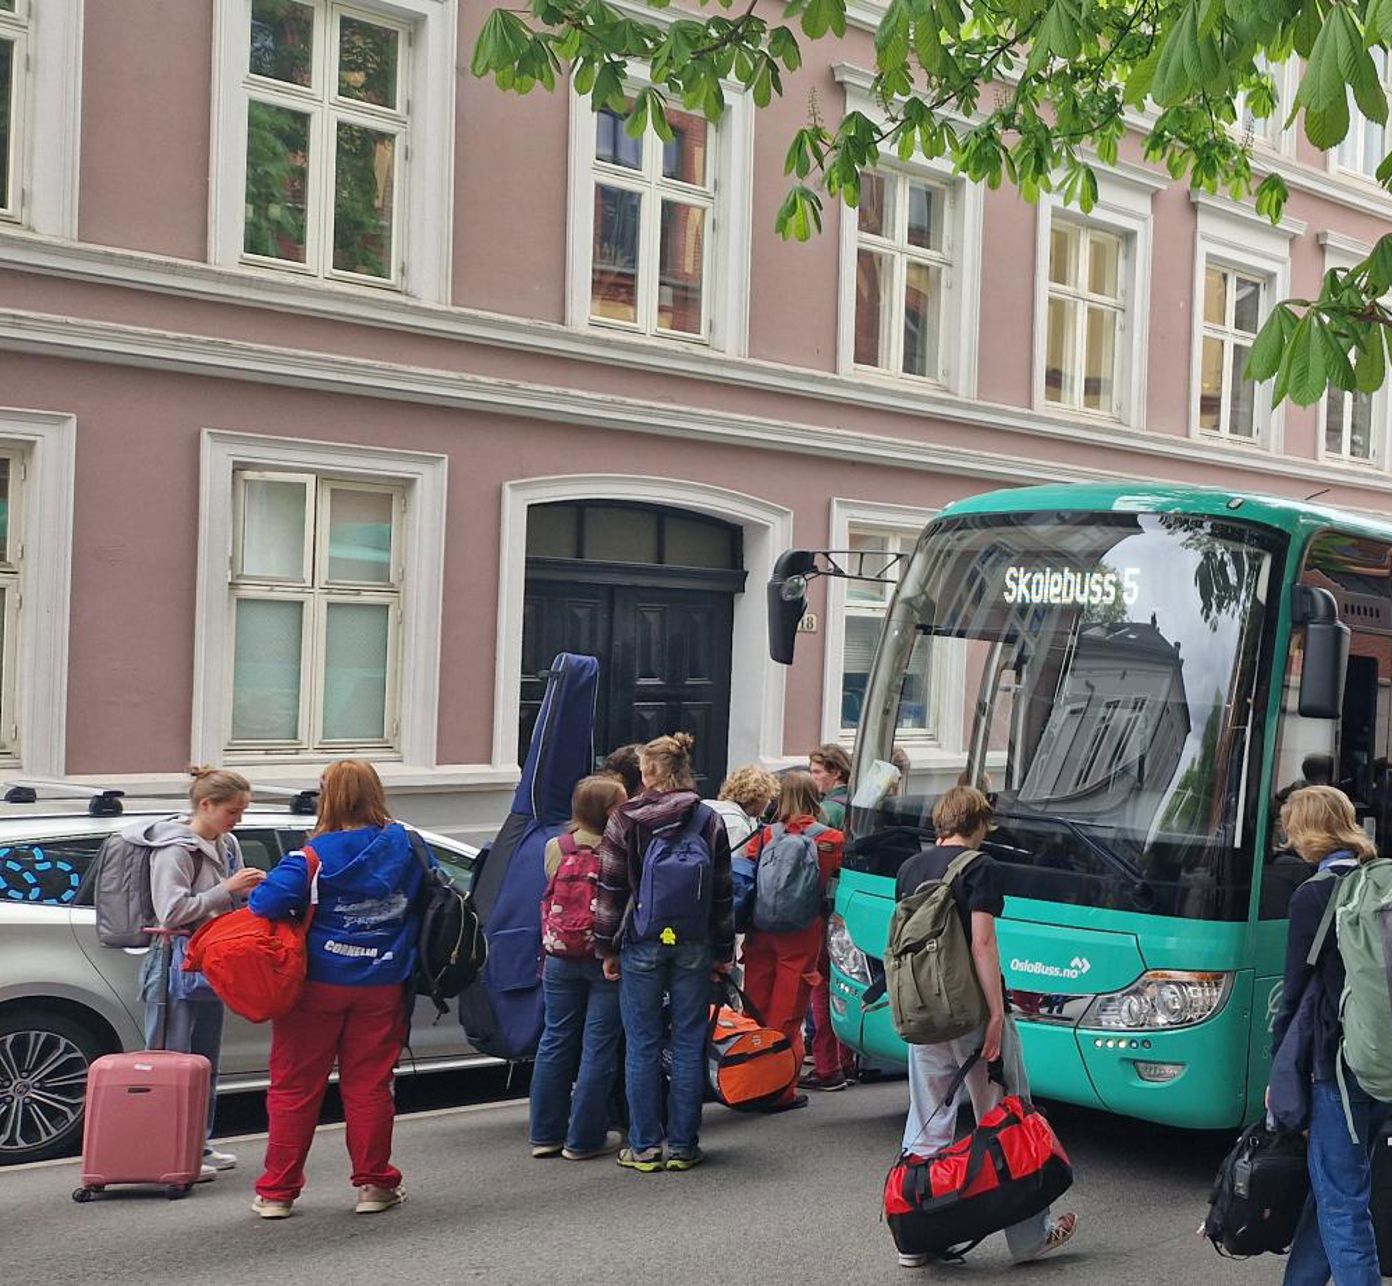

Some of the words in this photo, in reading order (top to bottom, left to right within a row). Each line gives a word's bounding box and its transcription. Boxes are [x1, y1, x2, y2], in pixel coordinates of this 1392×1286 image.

[1003, 566, 1117, 605] Skolebuss
[1121, 568, 1142, 605] 5
[1010, 958, 1079, 979] OsloBuss.no
